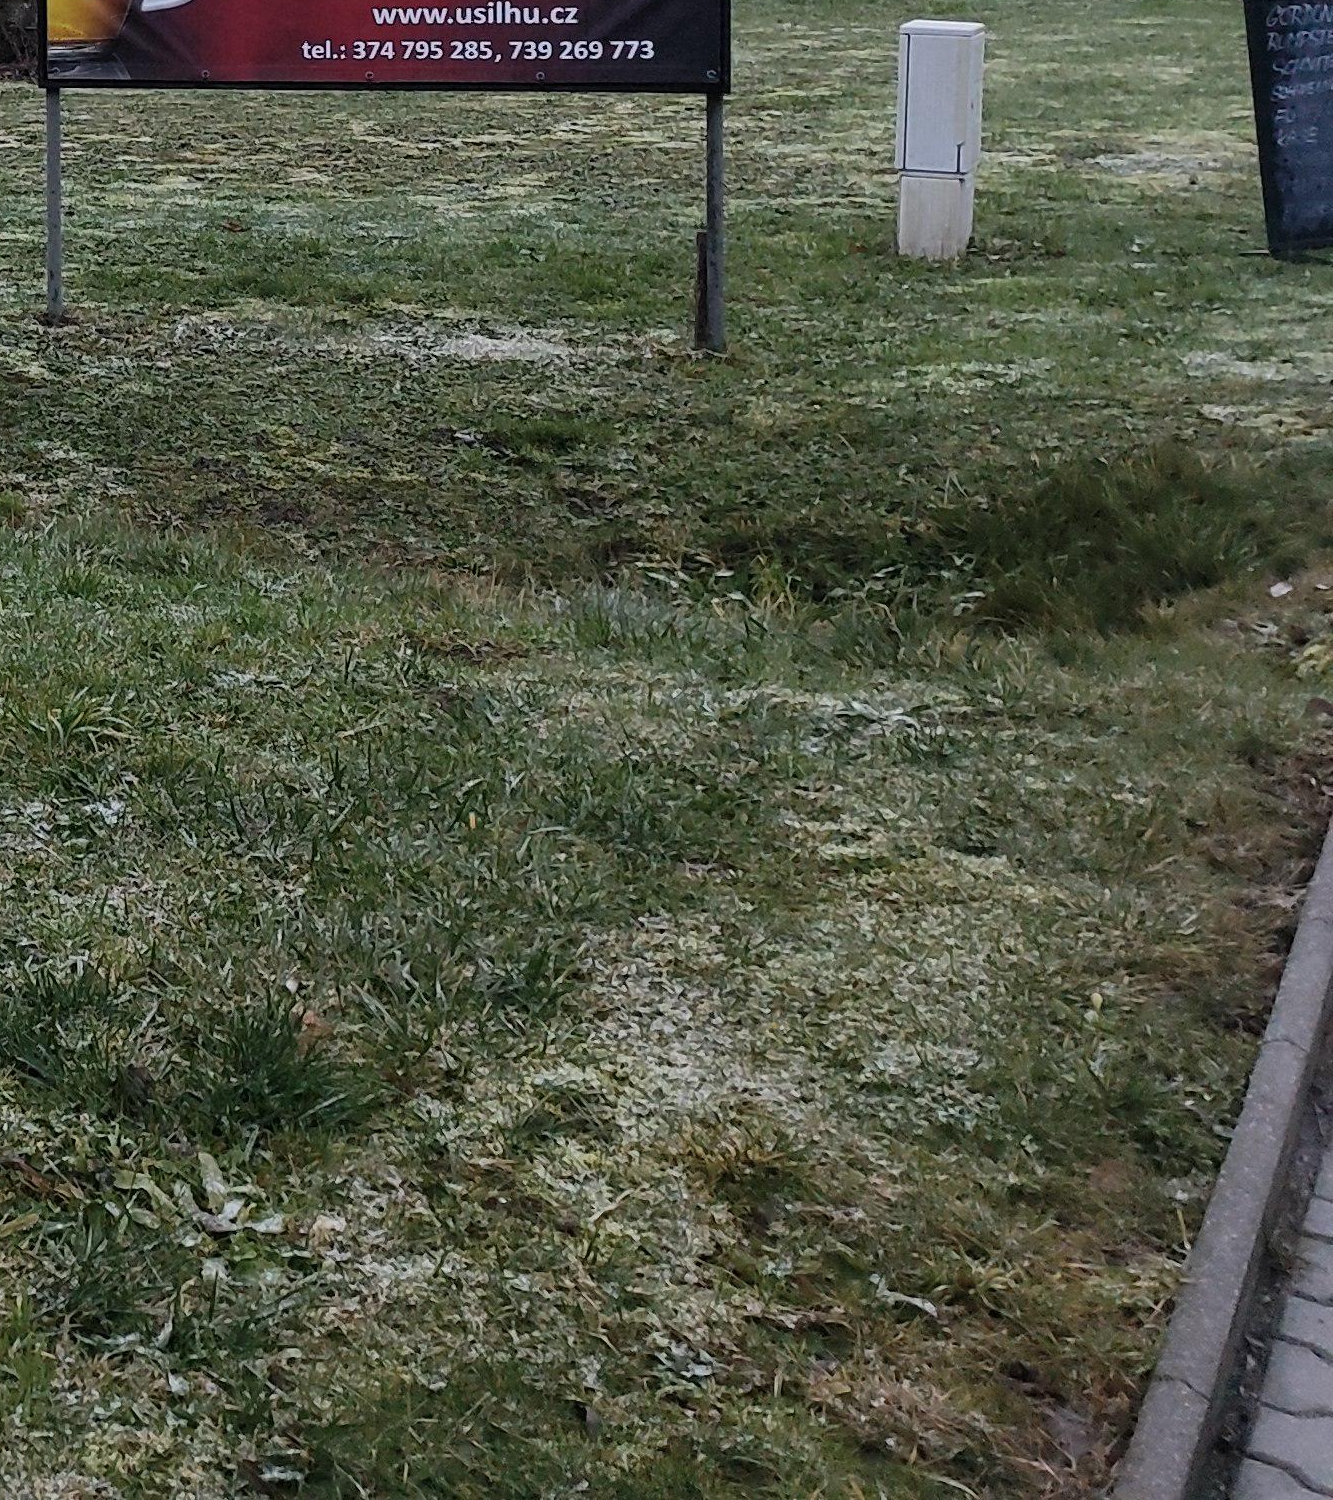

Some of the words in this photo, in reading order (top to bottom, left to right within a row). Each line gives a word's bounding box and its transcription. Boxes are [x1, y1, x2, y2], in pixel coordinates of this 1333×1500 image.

[371, 1, 579, 25] www.usilhu.cz
[301, 40, 347, 60] tel.:
[351, 40, 396, 60] 374
[401, 40, 444, 60] 795
[449, 40, 502, 63] 285,
[508, 40, 553, 60] 739
[559, 40, 604, 60] 269
[609, 40, 655, 60] 773
